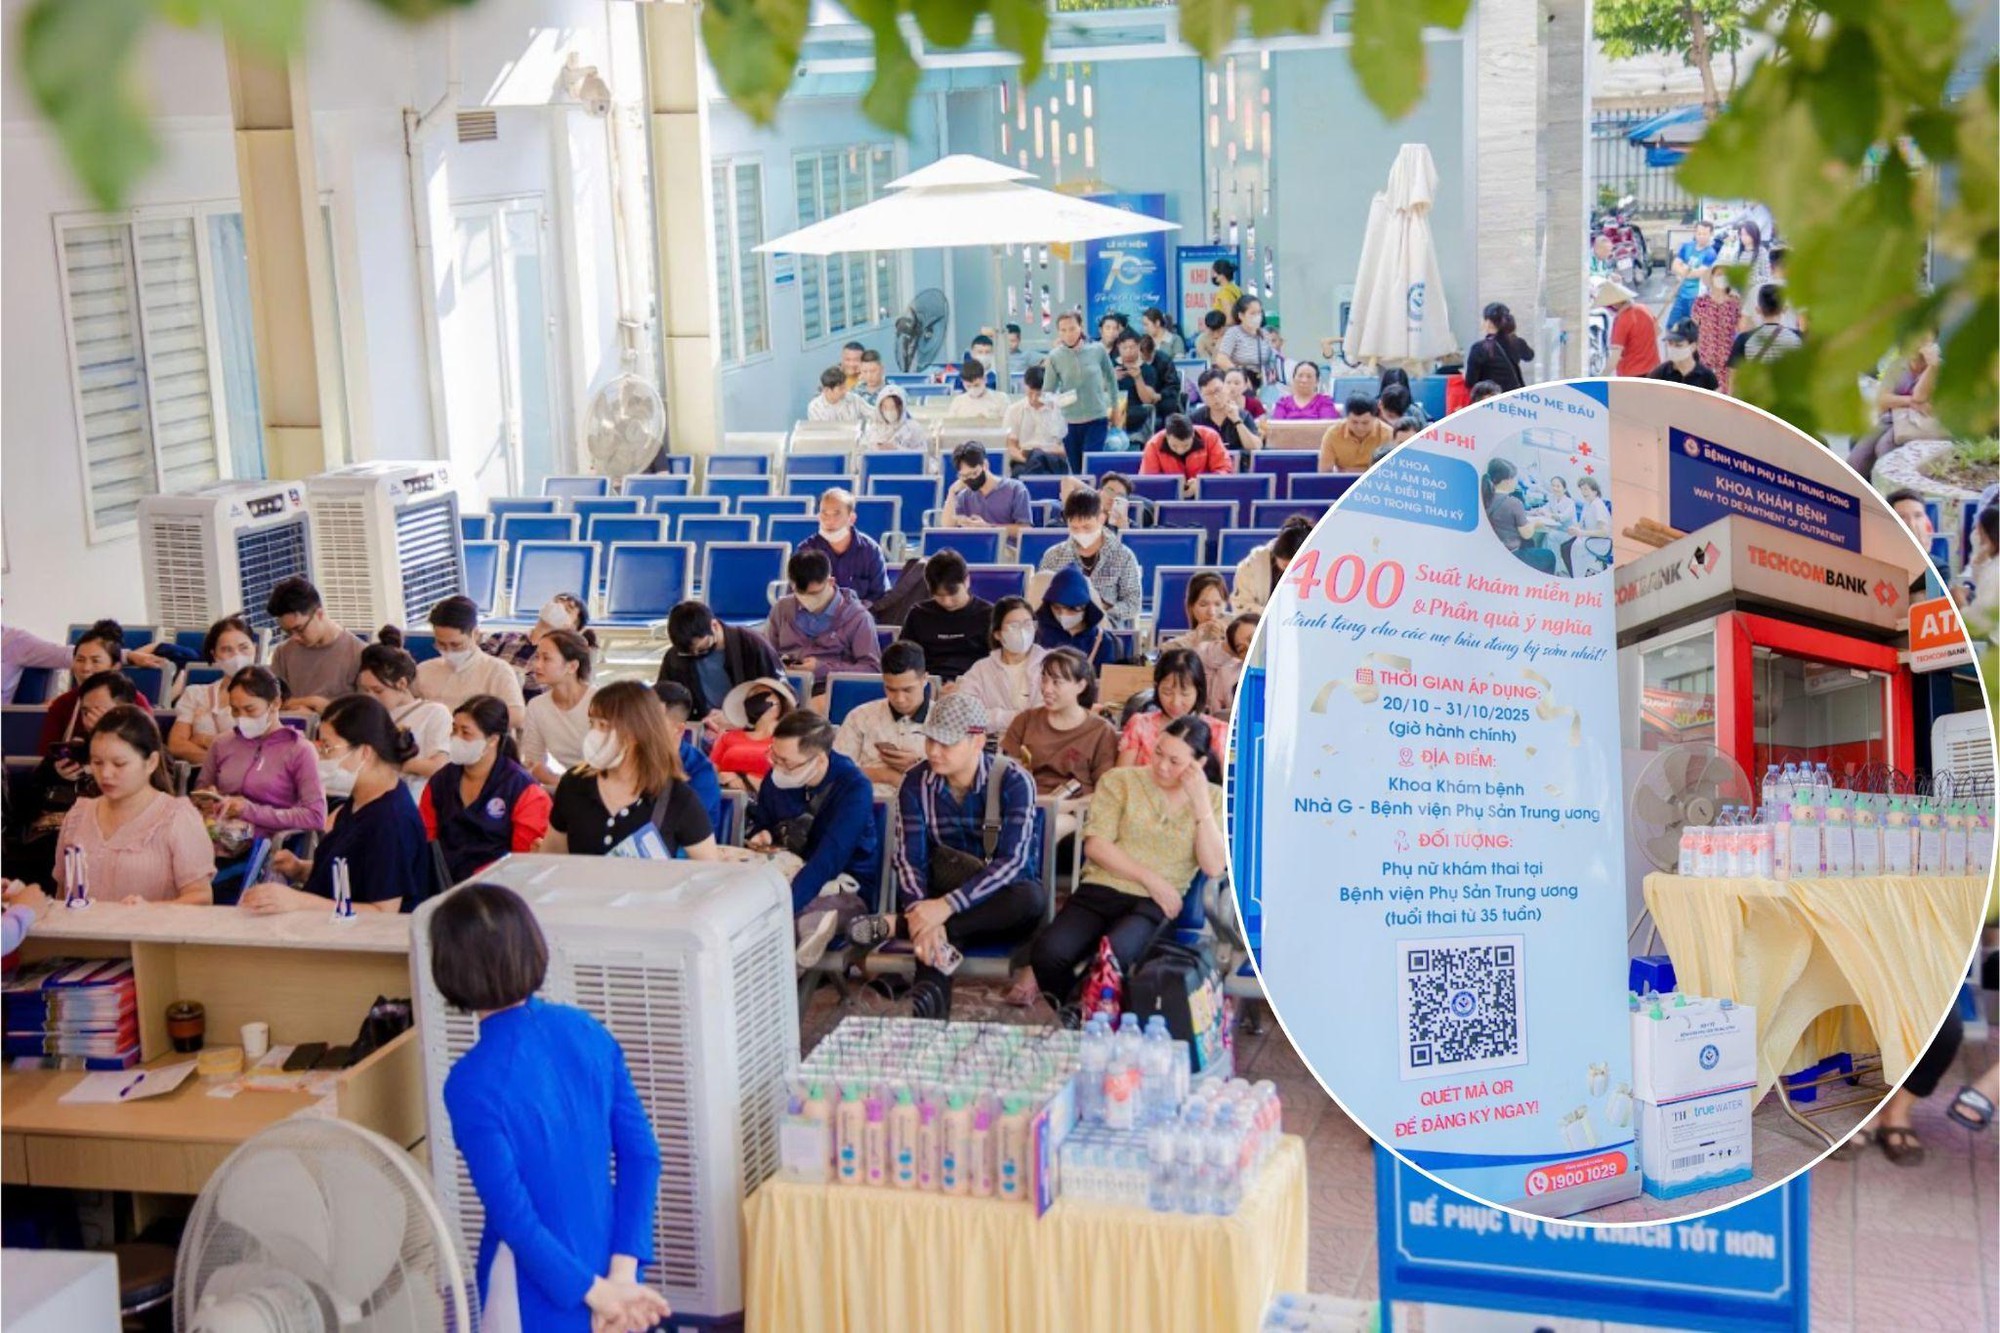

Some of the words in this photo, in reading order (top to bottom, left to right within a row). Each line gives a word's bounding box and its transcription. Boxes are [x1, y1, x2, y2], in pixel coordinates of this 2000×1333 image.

[1499, 401, 1538, 421] BỆNH
[1444, 431, 1476, 451] PHÍ
[1399, 457, 1430, 473] KHOA
[1375, 481, 1392, 493] VÀ
[1733, 458, 1756, 475] VIỆN
[1757, 467, 1776, 482] PHỤ
[1777, 473, 1795, 489] SẢN
[1797, 481, 1825, 500] TRUNG
[1826, 492, 1850, 509] ƯƠNG
[1384, 498, 1422, 514] TRONG
[1424, 505, 1448, 519] THAI
[1715, 475, 1753, 500] KHOA
[1756, 489, 1793, 513] KHÁM
[1795, 502, 1828, 525] BỆNH
[1693, 486, 1714, 501] WAY
[1715, 493, 1730, 506] TO
[1730, 499, 1786, 524] DEPARTMENT
[1787, 517, 1799, 528] OF
[1800, 522, 1846, 544] OUTPATIENT
[1283, 549, 1406, 610] 400
[1747, 545, 1868, 597] TECHCOMBANK
[1415, 563, 1462, 587] Suất
[1466, 573, 1520, 598] khám
[1524, 581, 1571, 603] miễn
[1573, 590, 1603, 609] phí
[1483, 609, 1520, 629] quà
[1523, 614, 1537, 634] ý
[1541, 616, 1593, 637] nghĩa
[1330, 614, 1367, 641] tặng
[1371, 620, 1399, 637] cho
[1401, 627, 1428, 641] các
[1429, 632, 1451, 646] mẹ
[1523, 639, 1539, 662] ký
[1916, 647, 1968, 664] TECHCOMBANK
[1379, 669, 1417, 688] THỜI
[1422, 675, 1464, 693] GIAN
[1468, 677, 1489, 695] ÁP
[1492, 683, 1542, 700] DỤNG:
[1383, 696, 1429, 714] 20/10
[1445, 702, 1531, 722] 31/10/2025
[1389, 720, 1421, 738] (giờ
[1426, 722, 1465, 740] hành
[1469, 727, 1518, 744] chính)
[1420, 748, 1450, 767] ĐỊA
[1454, 747, 1497, 768] ĐIỂM:
[1388, 776, 1432, 792] Khoa
[1436, 778, 1481, 794] Khám
[1486, 781, 1525, 798] bệnh
[1294, 797, 1332, 813] Nhà
[1337, 798, 1353, 814] G
[1371, 800, 1413, 818] Bệnh
[1418, 802, 1451, 819] viện
[1456, 803, 1484, 821] Phụ
[1488, 802, 1516, 819] Sản
[1520, 805, 1561, 822] Trung
[1564, 808, 1601, 823] ương
[1418, 828, 1449, 848] ĐỐI
[1453, 833, 1514, 851] TƯỢNG:
[1382, 861, 1413, 879] Phụ
[1417, 861, 1440, 876] nữ
[1442, 861, 1487, 876] khám
[1491, 861, 1520, 876] thai
[1524, 861, 1544, 878] tại
[1339, 886, 1384, 904] Bệnh
[1388, 886, 1424, 903] viện
[1429, 885, 1458, 902] Phụ
[1462, 883, 1491, 899] Sản
[1495, 884, 1536, 901] Trung
[1540, 885, 1579, 900] ương
[1385, 906, 1422, 927] (tuổi
[1427, 909, 1457, 924] thai
[1461, 908, 1476, 923] từ
[1480, 908, 1498, 922] 35
[1502, 905, 1542, 922] tuần)
[1420, 1085, 1462, 1107] QUÉT
[1465, 1081, 1489, 1100] MÃ
[1492, 1079, 1514, 1095] QR
[1394, 1115, 1418, 1138] ĐỂ
[1421, 1112, 1467, 1133] ĐĂNG
[1469, 1106, 1491, 1124] KÝ
[1494, 1100, 1540, 1120] NGAY!
[1549, 1170, 1584, 1190] 1900
[1586, 1162, 1618, 1181] 1029
[1409, 1193, 1438, 1227] ĐỂ
[1443, 1203, 1504, 1236] PHỤC
[1677, 1218, 1720, 1253] TỐT
